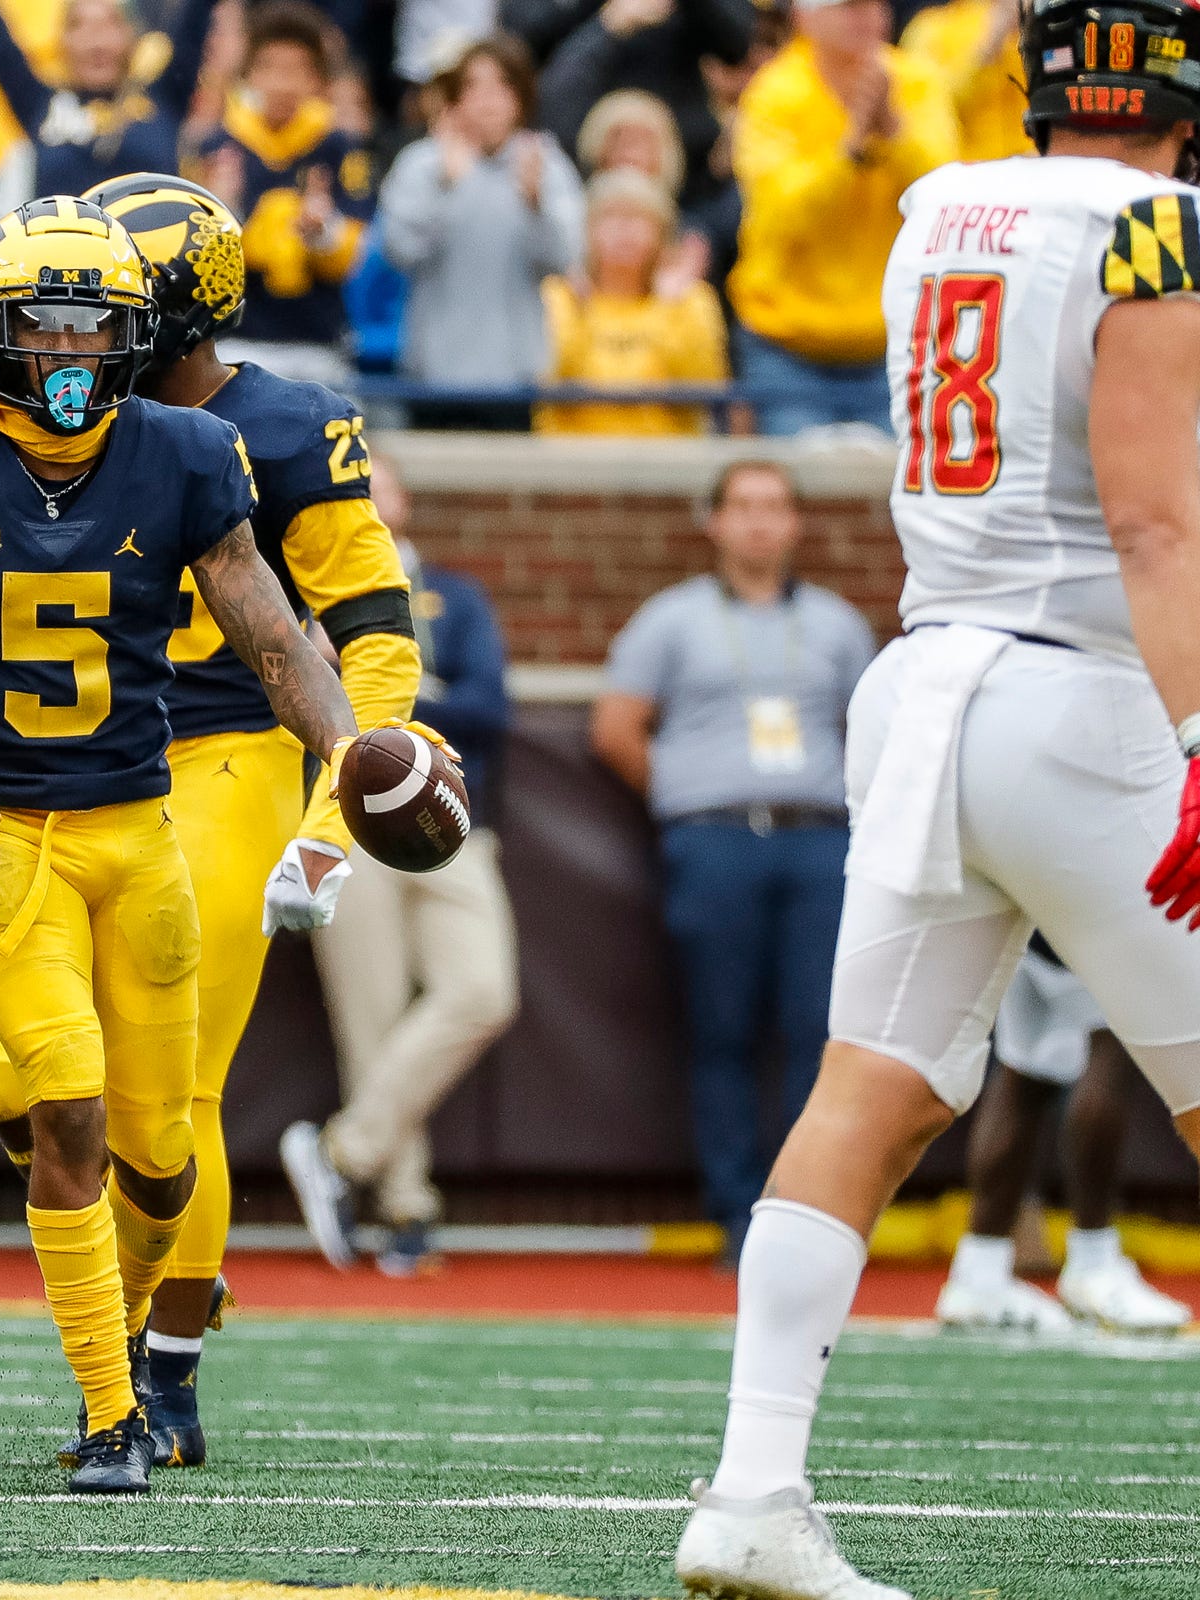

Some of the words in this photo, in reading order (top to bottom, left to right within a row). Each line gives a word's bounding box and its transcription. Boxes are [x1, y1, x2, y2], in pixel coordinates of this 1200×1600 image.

[1084, 22, 1135, 71] 18
[1065, 86, 1145, 113] TERPS
[62, 270, 79, 283] M
[905, 270, 1006, 494] 18
[1, 571, 111, 738] 5
